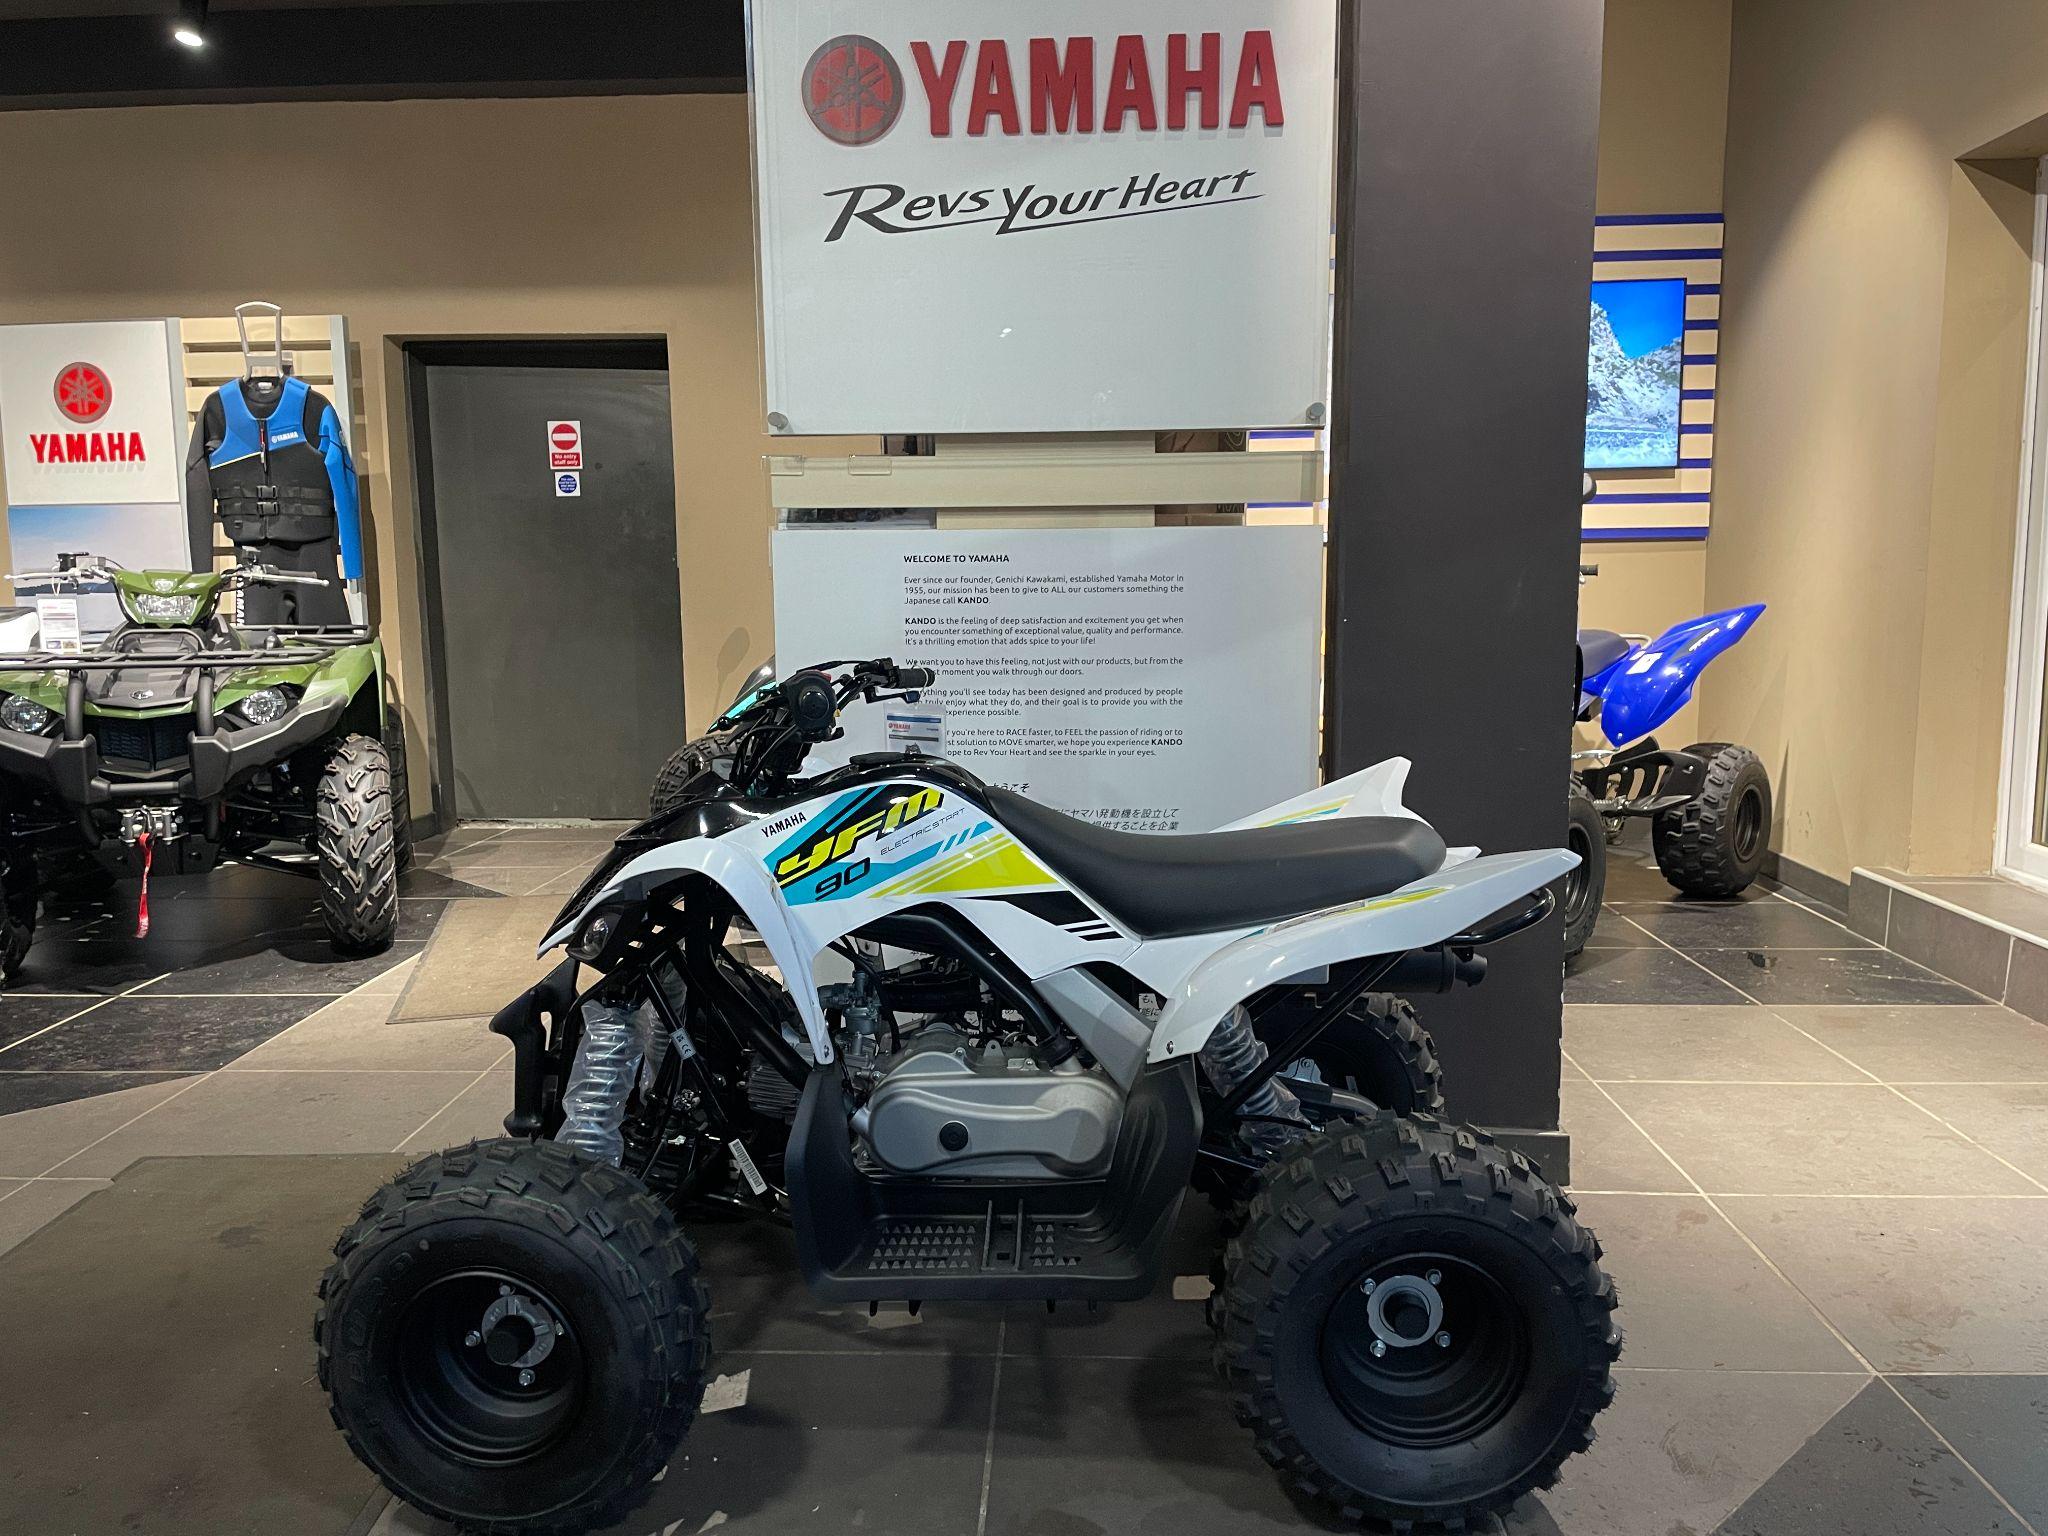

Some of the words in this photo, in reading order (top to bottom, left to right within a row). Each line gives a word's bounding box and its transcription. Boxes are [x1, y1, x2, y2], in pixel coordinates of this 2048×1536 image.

[910, 30, 1284, 136] YAMAHA
[822, 184, 995, 242] Revs
[995, 184, 1119, 235] Your
[1118, 169, 1257, 209] Heart
[30, 432, 146, 463] YAMAHA
[960, 576, 994, 584] founder,
[1026, 576, 1067, 584] Kawakami,
[1150, 575, 1174, 584] Motor
[905, 587, 926, 595] 1955,
[943, 586, 972, 594] mission
[975, 586, 988, 594] has
[1022, 586, 1038, 595] give
[904, 597, 940, 606] Japanese
[942, 596, 955, 604] call
[961, 616, 988, 626] feeling
[990, 616, 998, 624] of
[1000, 617, 1020, 625] deep
[1146, 617, 1160, 625] get
[962, 627, 1002, 636] something
[1015, 626, 1060, 636] exceptional
[1061, 626, 1084, 635] value,
[1086, 626, 1113, 636] quality
[1131, 626, 1183, 635] performance.
[925, 638, 955, 646] thrilling
[991, 637, 1007, 645] that
[1009, 637, 1027, 646] adds
[1030, 638, 1049, 646] spice
[940, 658, 954, 666] you
[985, 657, 1000, 665] this
[1001, 657, 1030, 666] feeling,
[1046, 657, 1061, 666] just
[1096, 657, 1132, 666] products,
[942, 668, 974, 676] moment
[1012, 668, 1042, 676] through
[1060, 668, 1084, 676] doors.
[950, 688, 970, 697] you'll
[988, 688, 1010, 697] today
[1050, 688, 1085, 697] designed
[1105, 688, 1142, 696] produced
[1144, 688, 1154, 696] by
[1156, 688, 1183, 696] people
[946, 699, 966, 707] enjoy
[991, 698, 1008, 707] they
[1010, 698, 1022, 706] do,
[1062, 698, 1079, 707] goal
[1102, 698, 1130, 707] provide
[988, 708, 1021, 717] possible.
[952, 728, 975, 738] you're
[1029, 728, 1053, 737] faster,
[1100, 728, 1128, 737] passion
[1140, 728, 1162, 738] riding
[999, 739, 1022, 747] MOVE
[1070, 738, 1090, 747] hope
[1107, 738, 1149, 746] experience
[1151, 738, 1182, 747] KANDO
[974, 749, 988, 757] Rev
[990, 749, 1007, 758] Your
[1010, 748, 1031, 757] Heart
[1032, 748, 1047, 758] and
[1064, 748, 1077, 757] the
[1078, 748, 1106, 757] sparkle
[1137, 750, 1156, 758] eyes.
[761, 812, 806, 838] YAMAHA
[815, 857, 870, 901] 90
